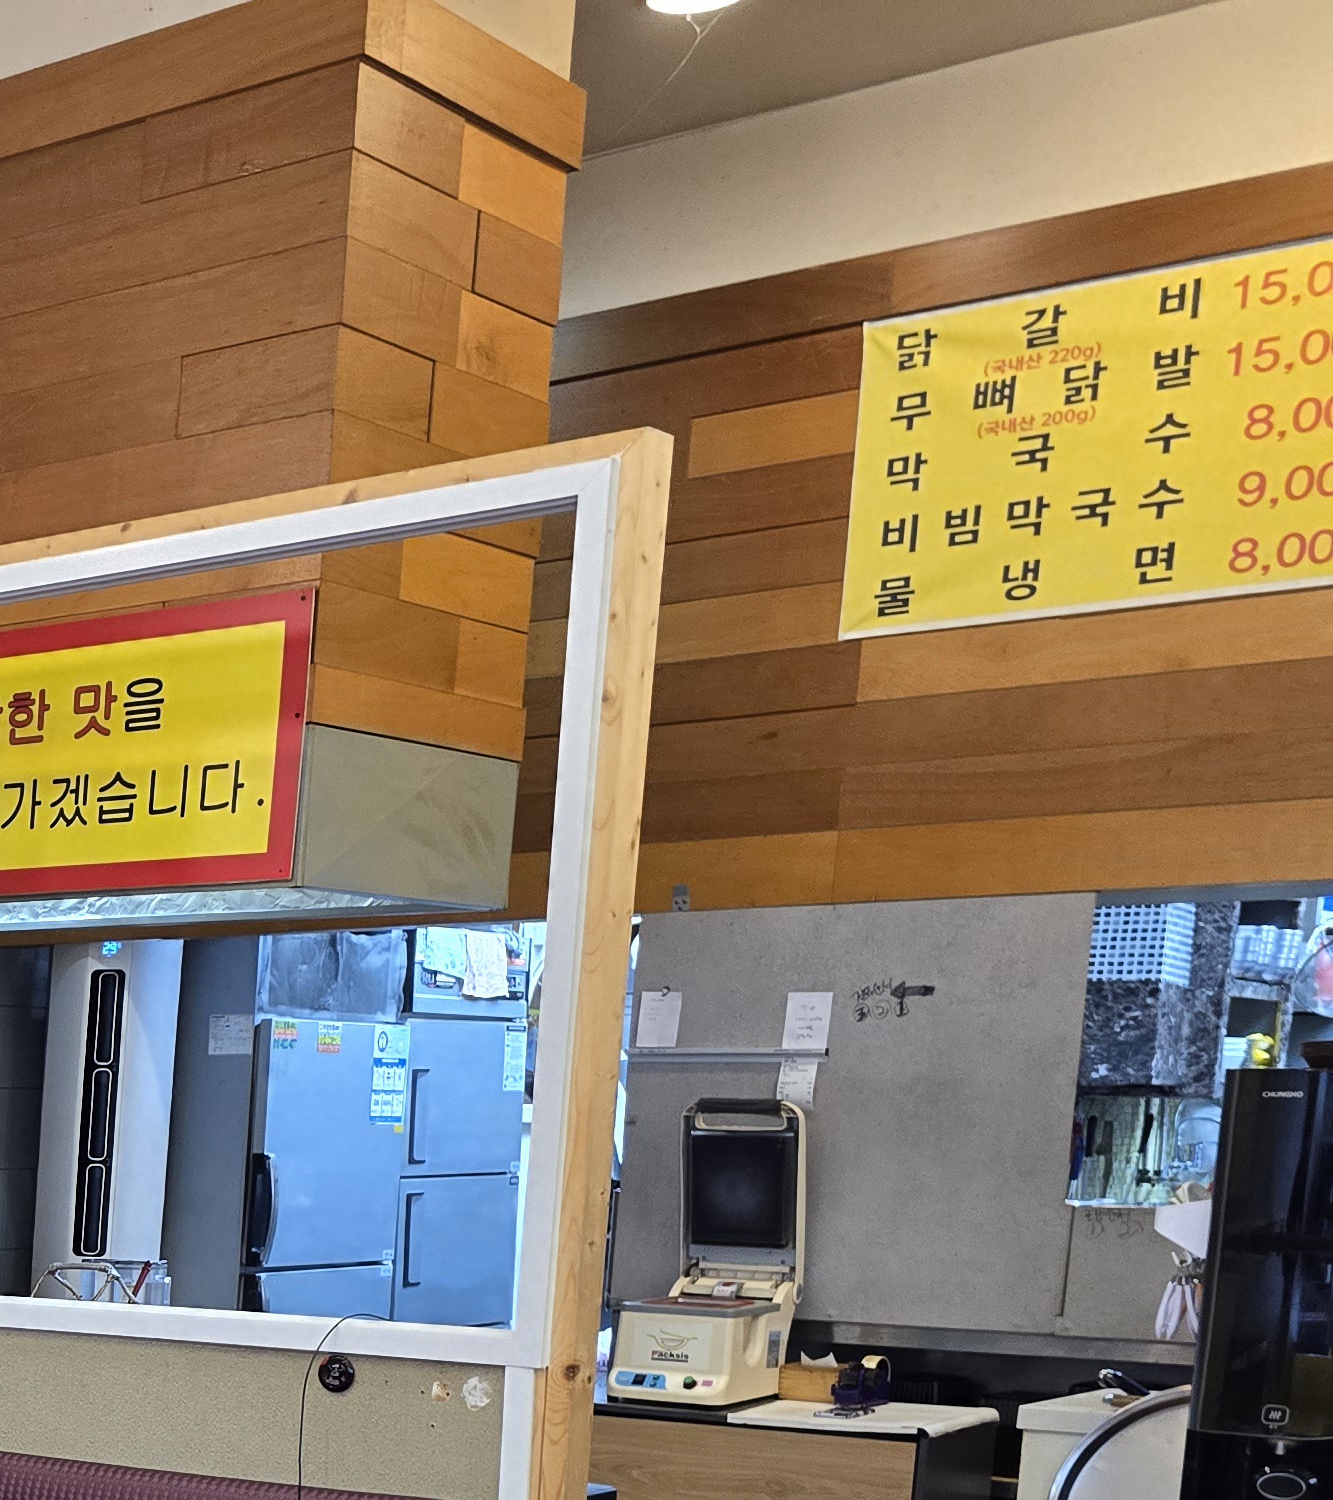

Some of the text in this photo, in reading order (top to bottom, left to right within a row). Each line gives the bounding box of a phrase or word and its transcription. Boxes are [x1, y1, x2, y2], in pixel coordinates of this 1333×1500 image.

[1049, 342, 1102, 367] 220g)
[1227, 329, 1333, 377] 15,0
[1040, 406, 1097, 428] 200g)
[72, 676, 165, 740] 맛을
[1, 759, 265, 830] 가겠습니다.
